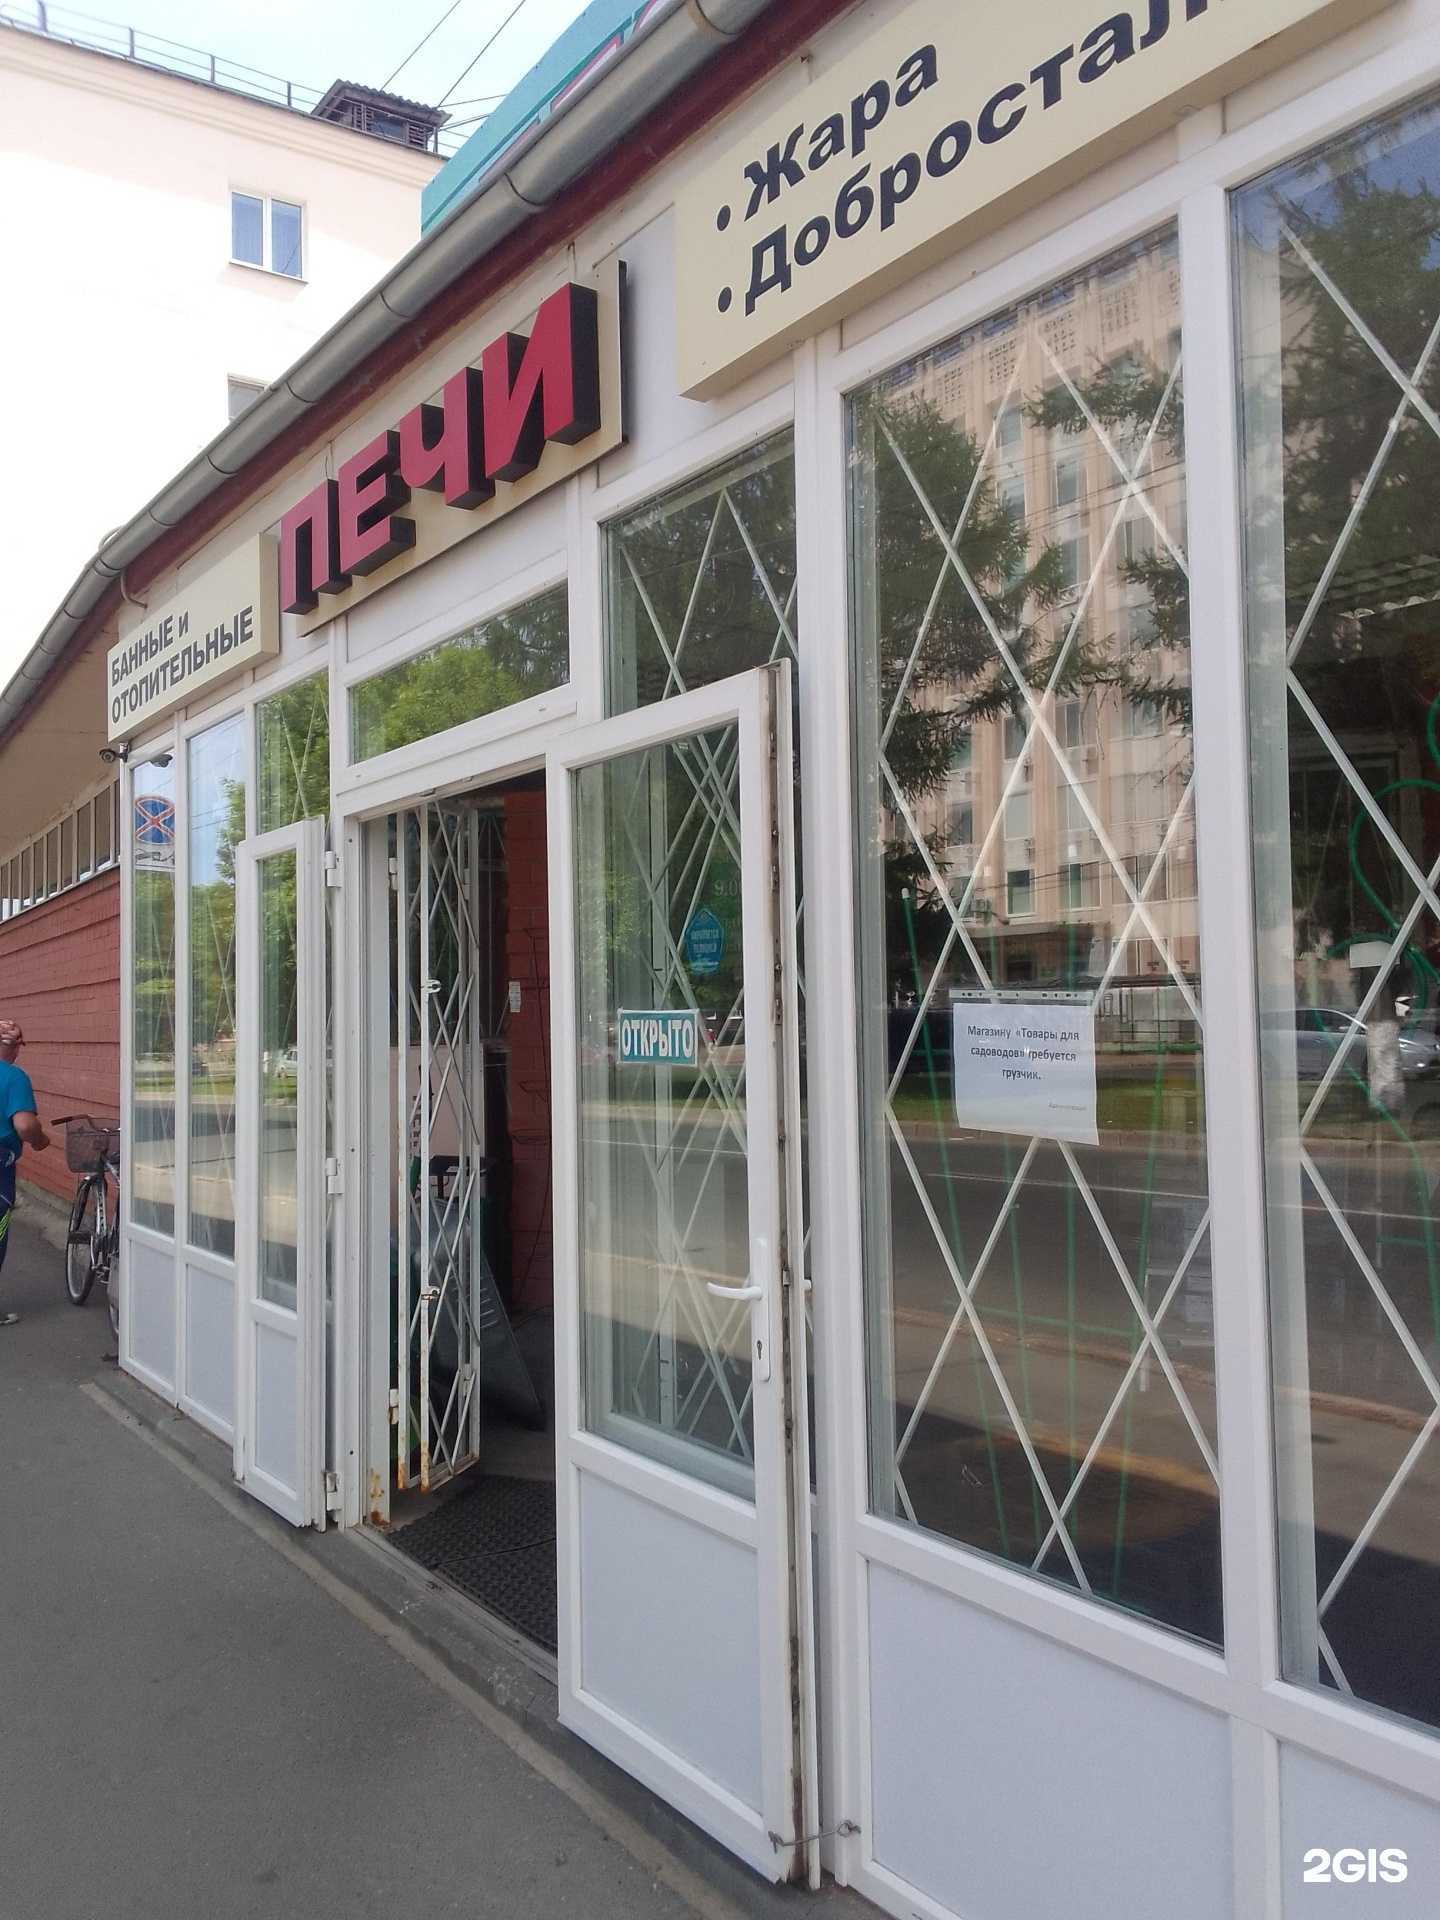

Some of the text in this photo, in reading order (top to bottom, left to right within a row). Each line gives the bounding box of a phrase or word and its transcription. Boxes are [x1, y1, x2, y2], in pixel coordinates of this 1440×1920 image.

[744, 44, 938, 221] Жара
[745, 0, 1210, 316] Добростал
[281, 282, 600, 615] ПЕЧИ
[112, 614, 174, 687] БАННЫЕ
[112, 595, 254, 714] ОТОПИТЕЛЬНЫЕ
[621, 1019, 694, 1058] ОТКРЫТО
[967, 1025, 1080, 1042] Магазину «Товары для
[970, 1047, 1025, 1059] садоводов»
